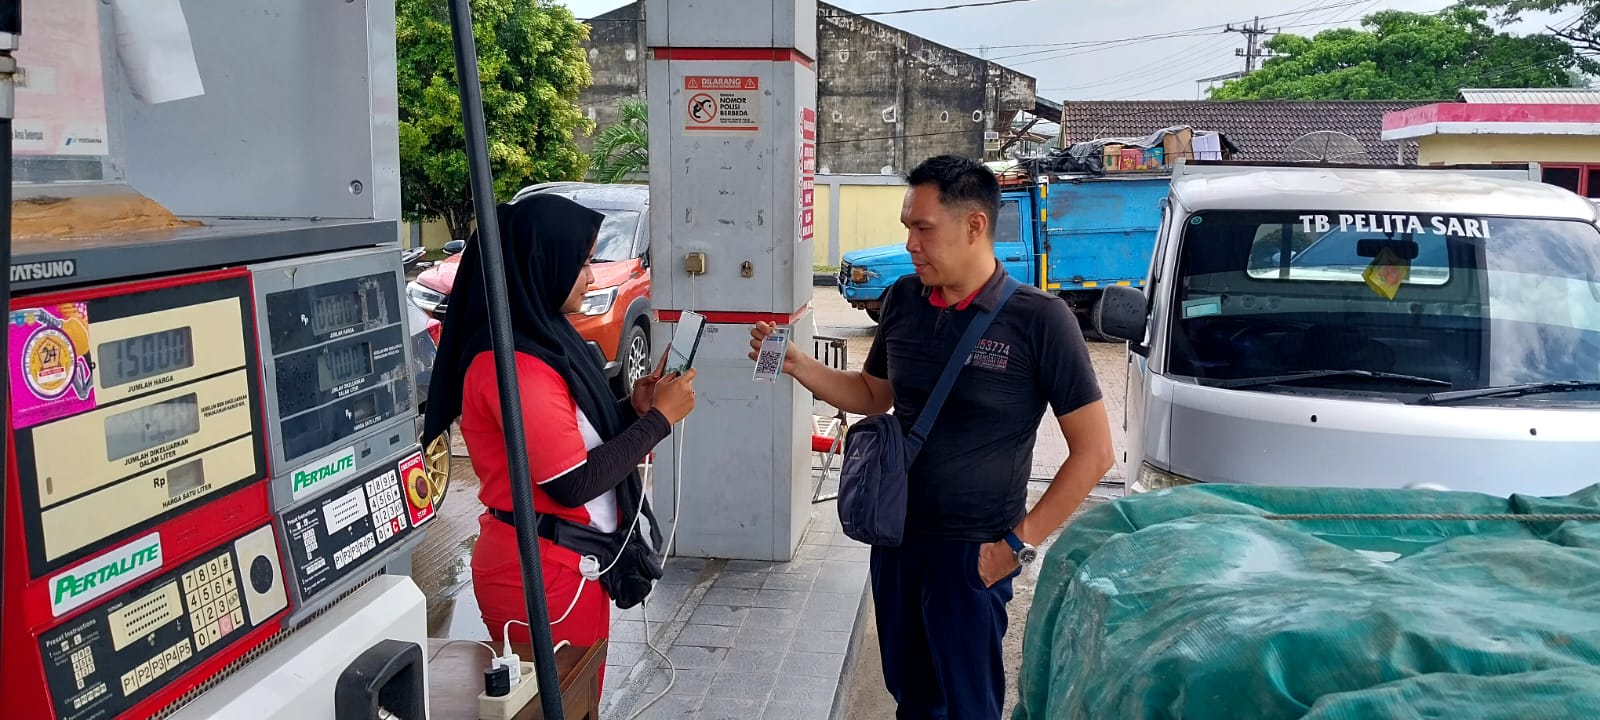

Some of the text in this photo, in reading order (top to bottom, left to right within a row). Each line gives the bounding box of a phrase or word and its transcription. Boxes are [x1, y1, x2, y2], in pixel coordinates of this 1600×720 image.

[1300, 215, 1491, 238] TB PELITA SARI
[10, 260, 74, 281] TATSUNO
[117, 329, 185, 379] 15000
[127, 375, 174, 393] JUMLAH HARGA
[124, 439, 189, 466] JUMLAH DIKELUARKAN
[140, 450, 176, 468] DALAM LITER
[153, 477, 166, 489] Rp
[293, 454, 353, 493] PERTALITE
[162, 483, 212, 508] HARGA SATU LITER
[393, 520, 399, 532] C
[55, 543, 159, 605] PERTALITE
[186, 575, 192, 588] 7
[199, 569, 206, 582] 8
[211, 563, 217, 576] 9
[191, 581, 221, 607] 4 5 6
[207, 607, 214, 620] 2
[219, 600, 226, 613] 3
[46, 619, 96, 648] Preset Instructions
[198, 633, 206, 646] 0
[234, 613, 241, 625] L
[124, 642, 190, 691] P1 P2 P3 P4 P5
